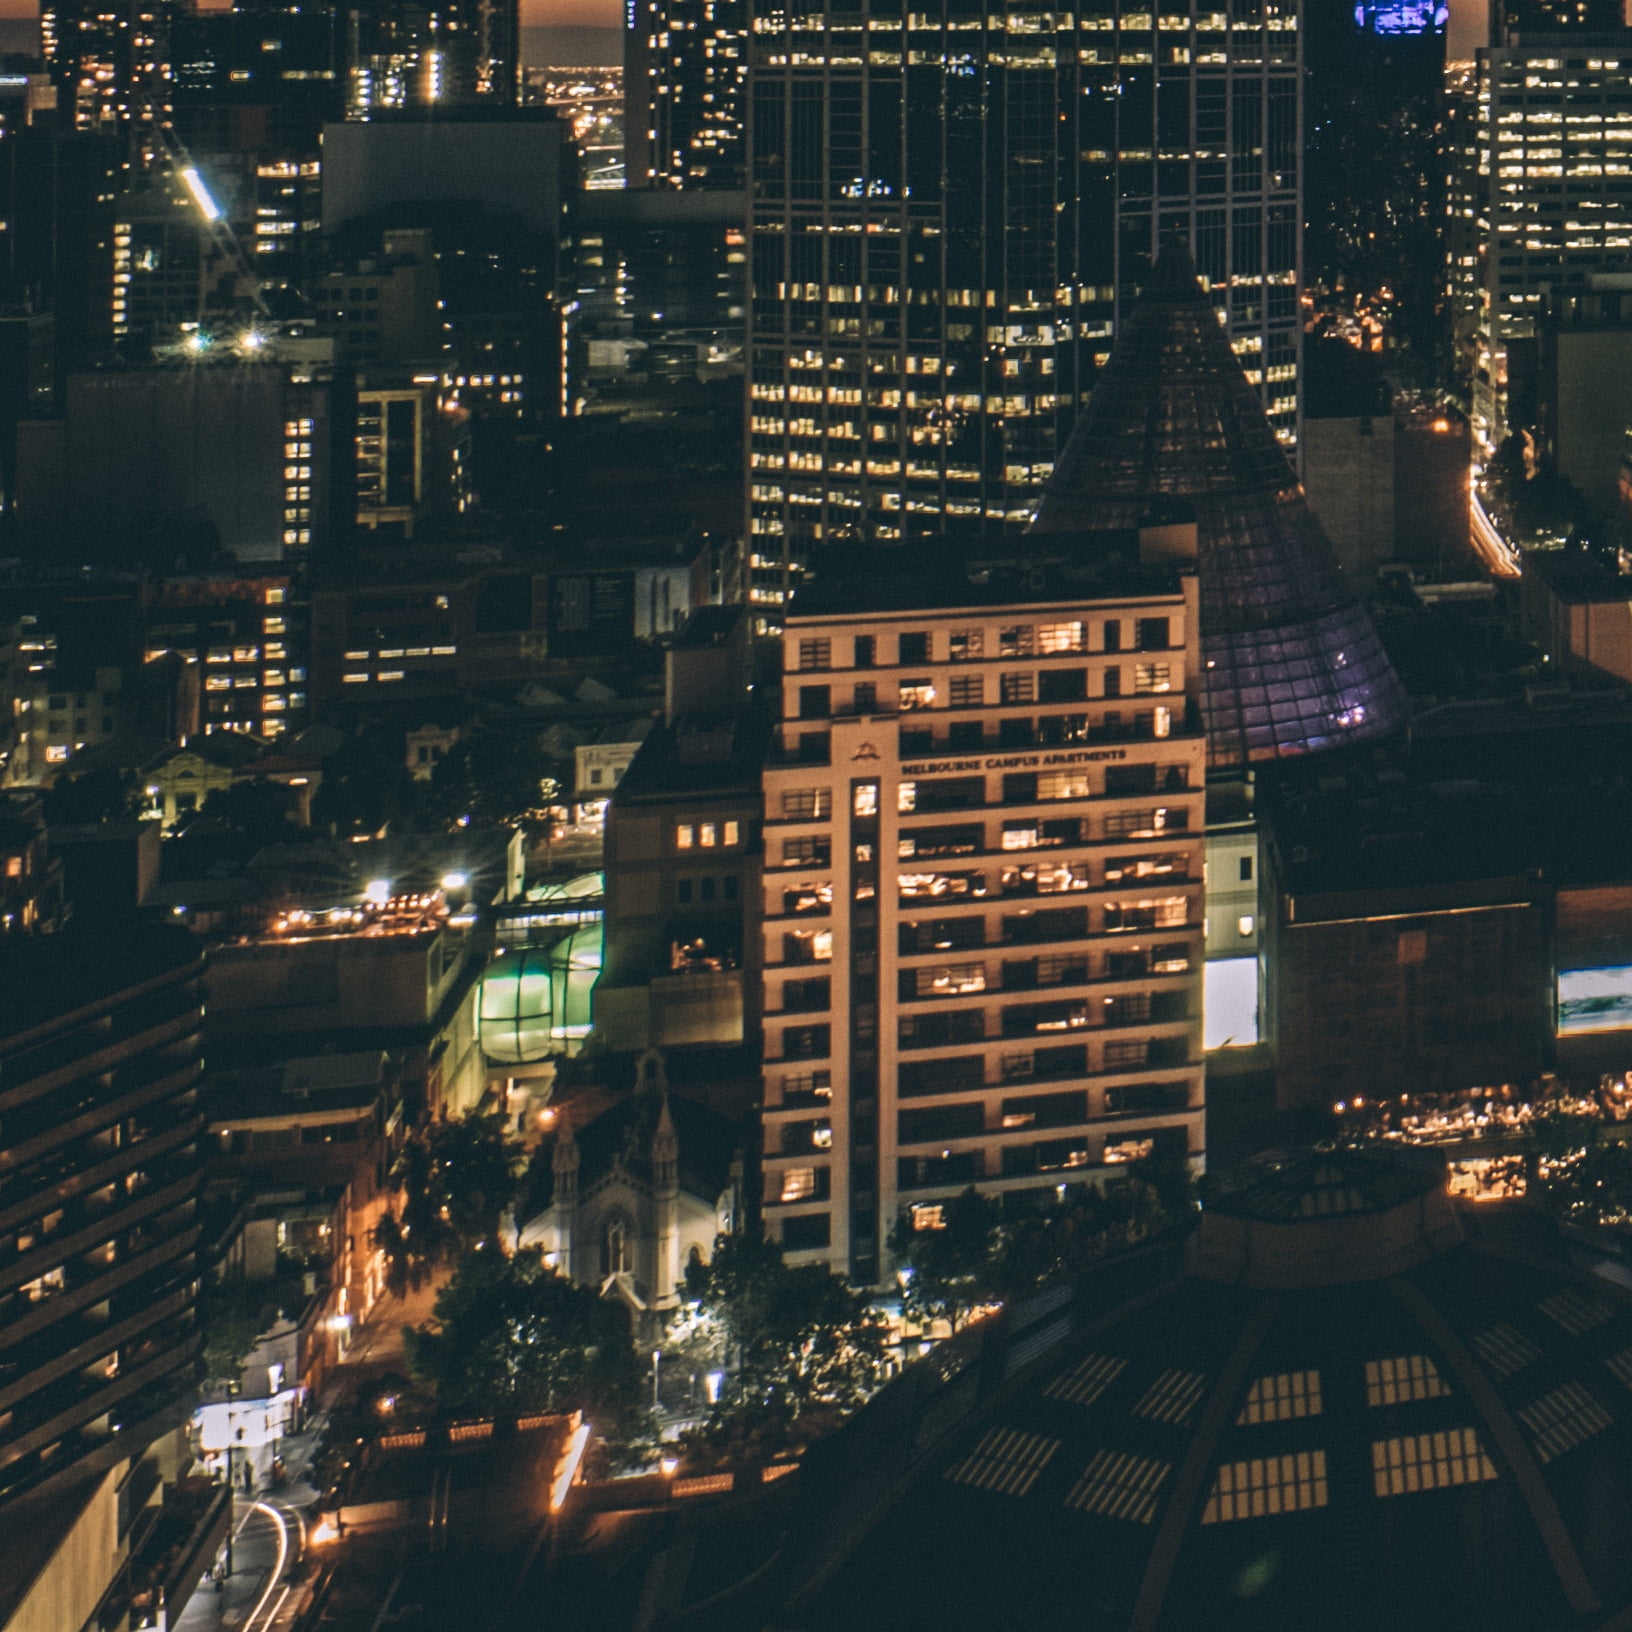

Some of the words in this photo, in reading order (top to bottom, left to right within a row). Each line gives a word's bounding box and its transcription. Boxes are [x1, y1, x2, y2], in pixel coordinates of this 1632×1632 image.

[902, 760, 982, 776] MELBOURNE
[985, 755, 1038, 769] CAMPUS
[1042, 749, 1126, 766] APARTMENTS
